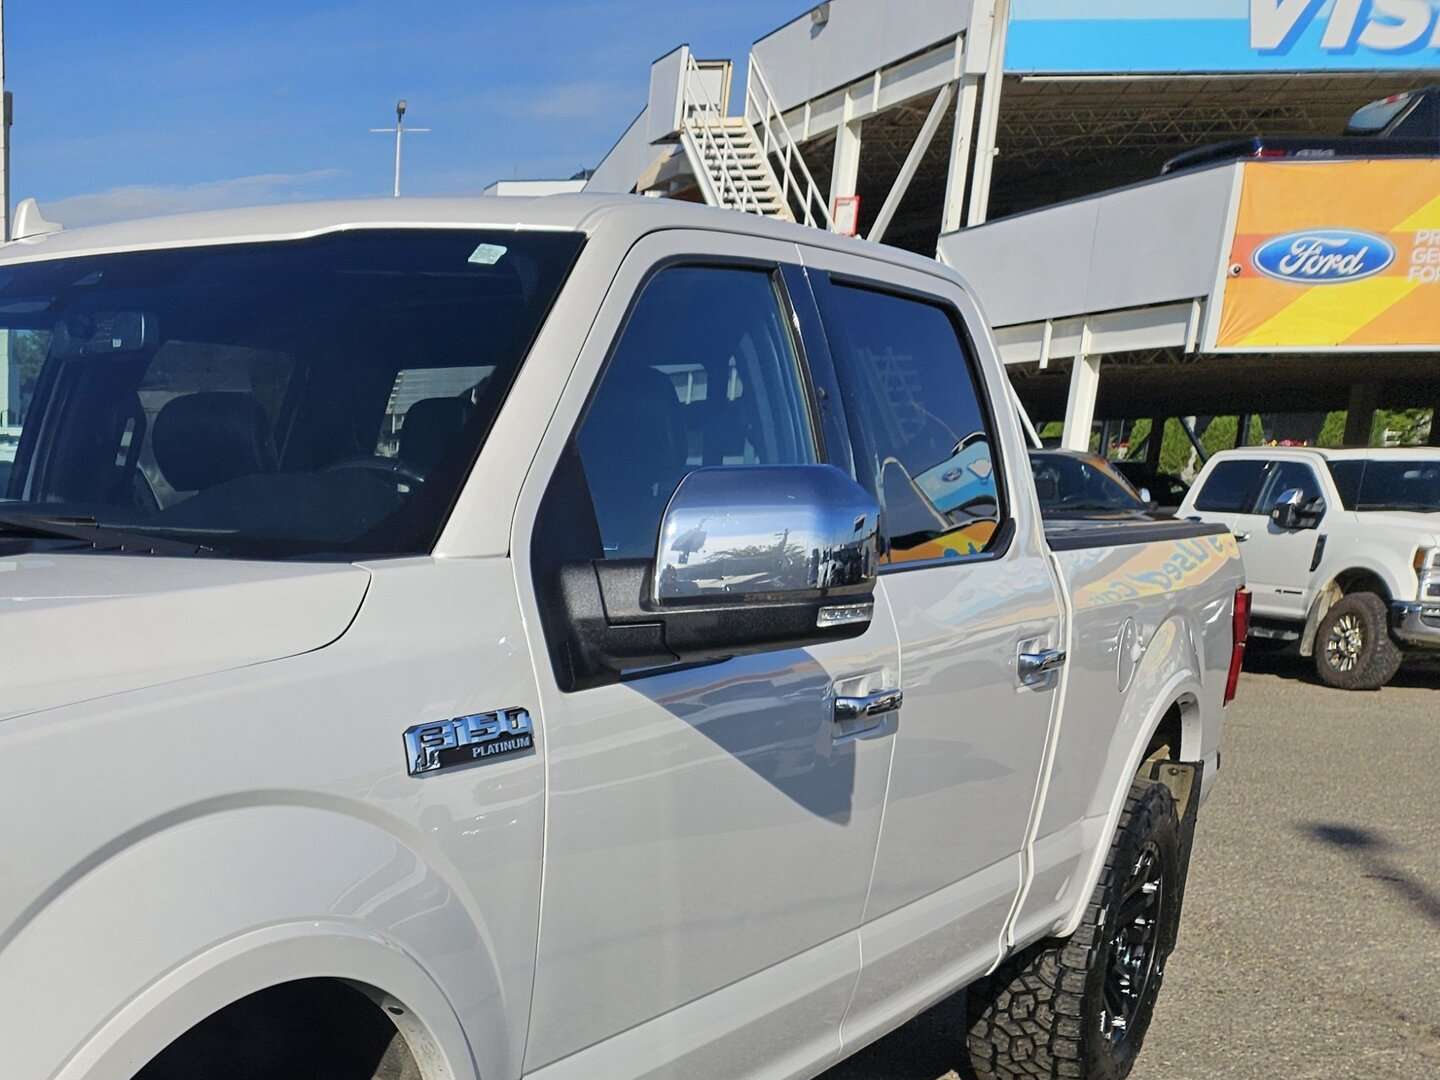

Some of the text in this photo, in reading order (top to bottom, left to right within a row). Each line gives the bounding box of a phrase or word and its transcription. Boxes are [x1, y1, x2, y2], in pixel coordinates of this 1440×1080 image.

[1248, 0, 1440, 50] VIS
[1279, 236, 1369, 275] Ford
[471, 736, 531, 758] PLATINUM
